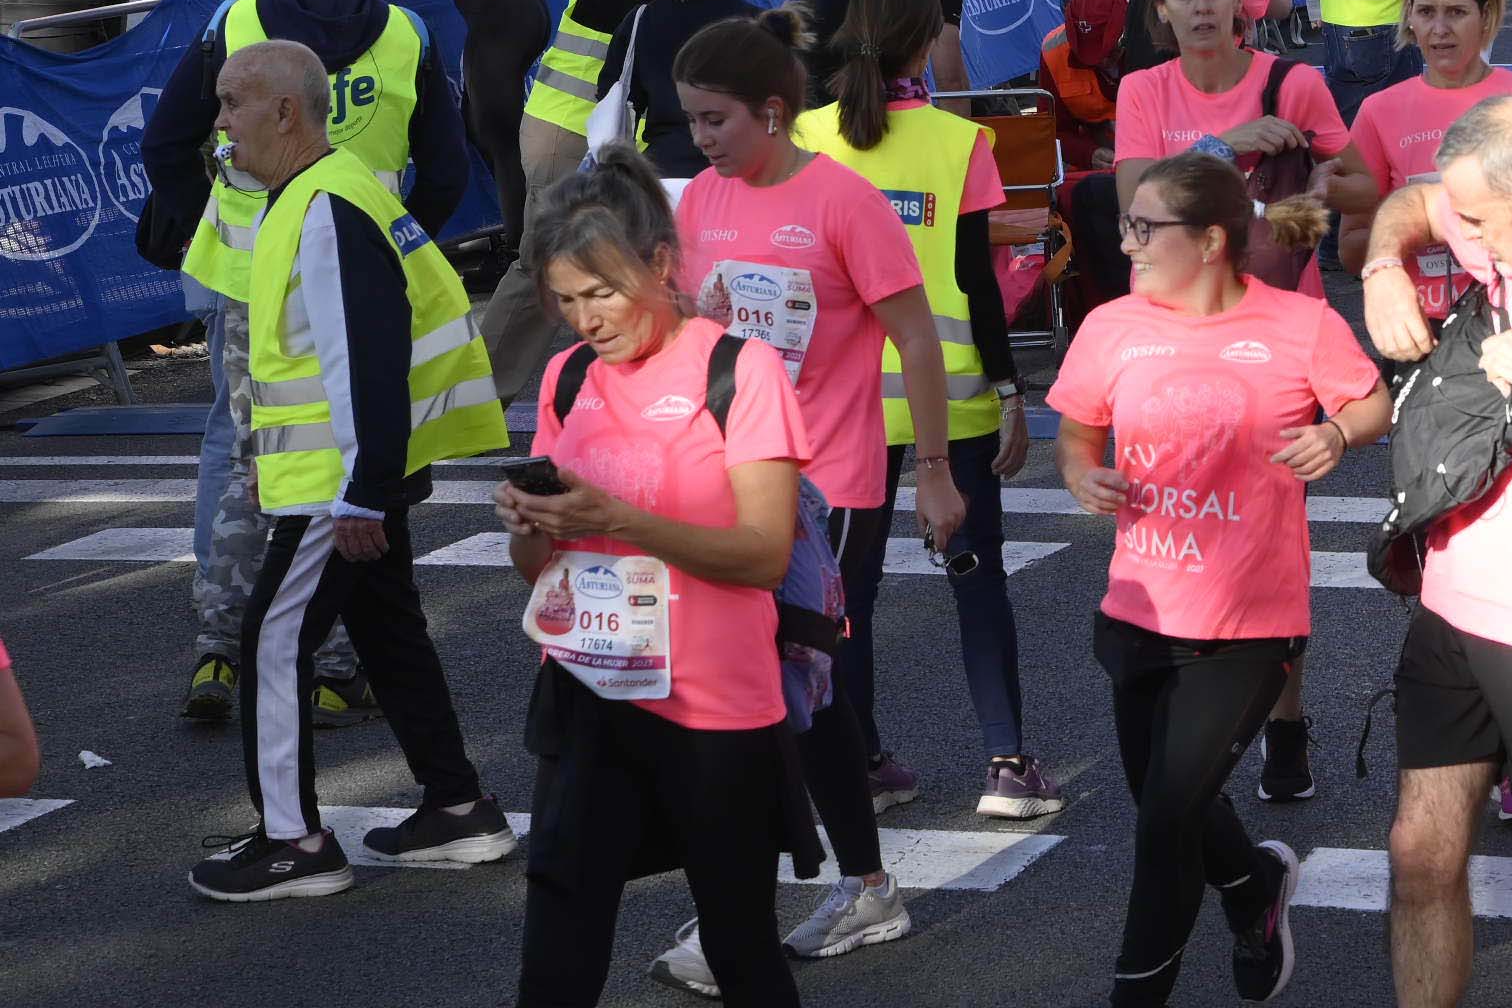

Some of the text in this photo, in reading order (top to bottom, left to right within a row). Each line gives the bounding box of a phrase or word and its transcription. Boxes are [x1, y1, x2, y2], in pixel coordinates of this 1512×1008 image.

[1399, 128, 1442, 149] OYSHO
[773, 232, 812, 244] ASTURIANA
[735, 281, 777, 297] ASTURIANA
[737, 307, 774, 327] 016
[574, 396, 605, 410] SHO
[1124, 524, 1203, 561] SUMA
[578, 577, 621, 591] ASTURIANA
[626, 575, 656, 585] SUMA
[579, 610, 620, 633] 016
[580, 637, 613, 651] 17674
[577, 655, 590, 665] DE
[592, 656, 604, 666] LA
[604, 657, 628, 668] MUJER
[608, 677, 657, 689] Santander
